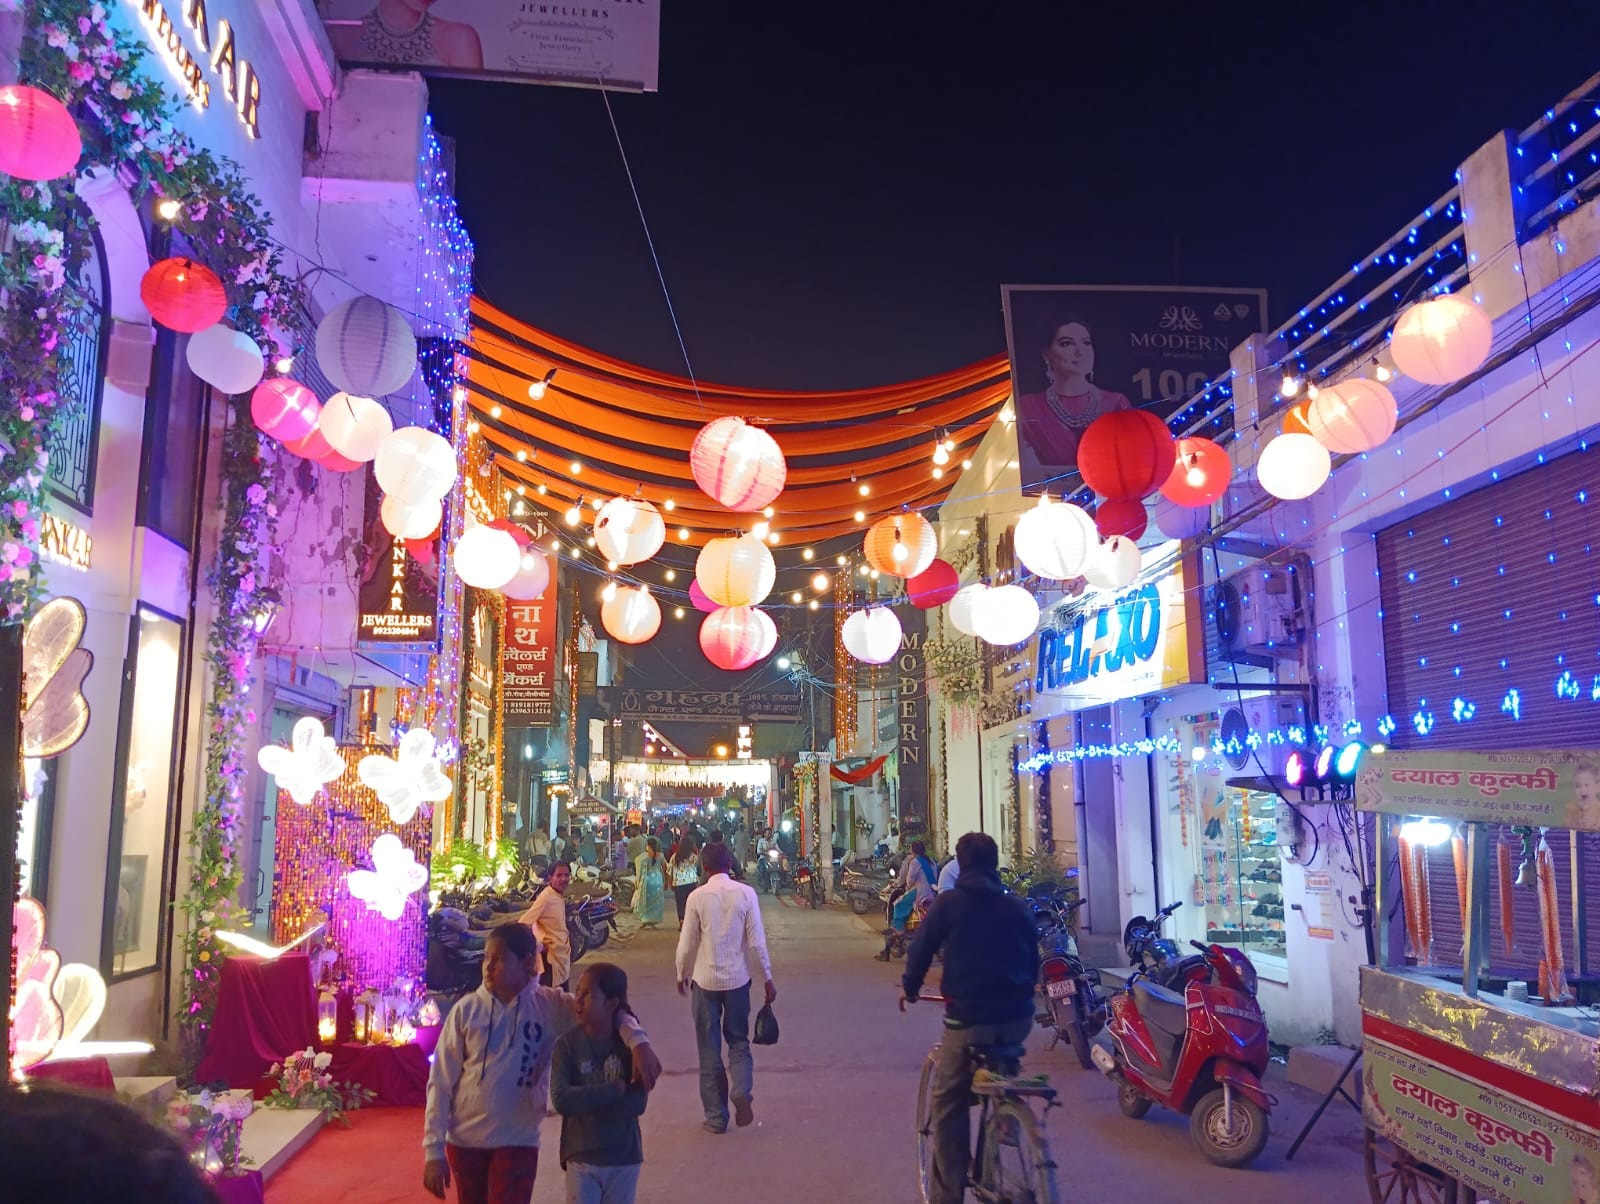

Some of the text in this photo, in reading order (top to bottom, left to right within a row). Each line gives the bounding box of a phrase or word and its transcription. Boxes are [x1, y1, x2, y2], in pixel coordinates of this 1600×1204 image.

[520, 3, 609, 18] JEWELLERS
[1130, 333, 1229, 352] MODERN
[361, 614, 432, 626] JEWELLERS
[1036, 582, 1161, 694] RELAXO
[900, 632, 920, 765] MODERN
[1391, 767, 1559, 795] दयाल कुल्फी
[1392, 1073, 1556, 1164] दयाल कुल्फी
